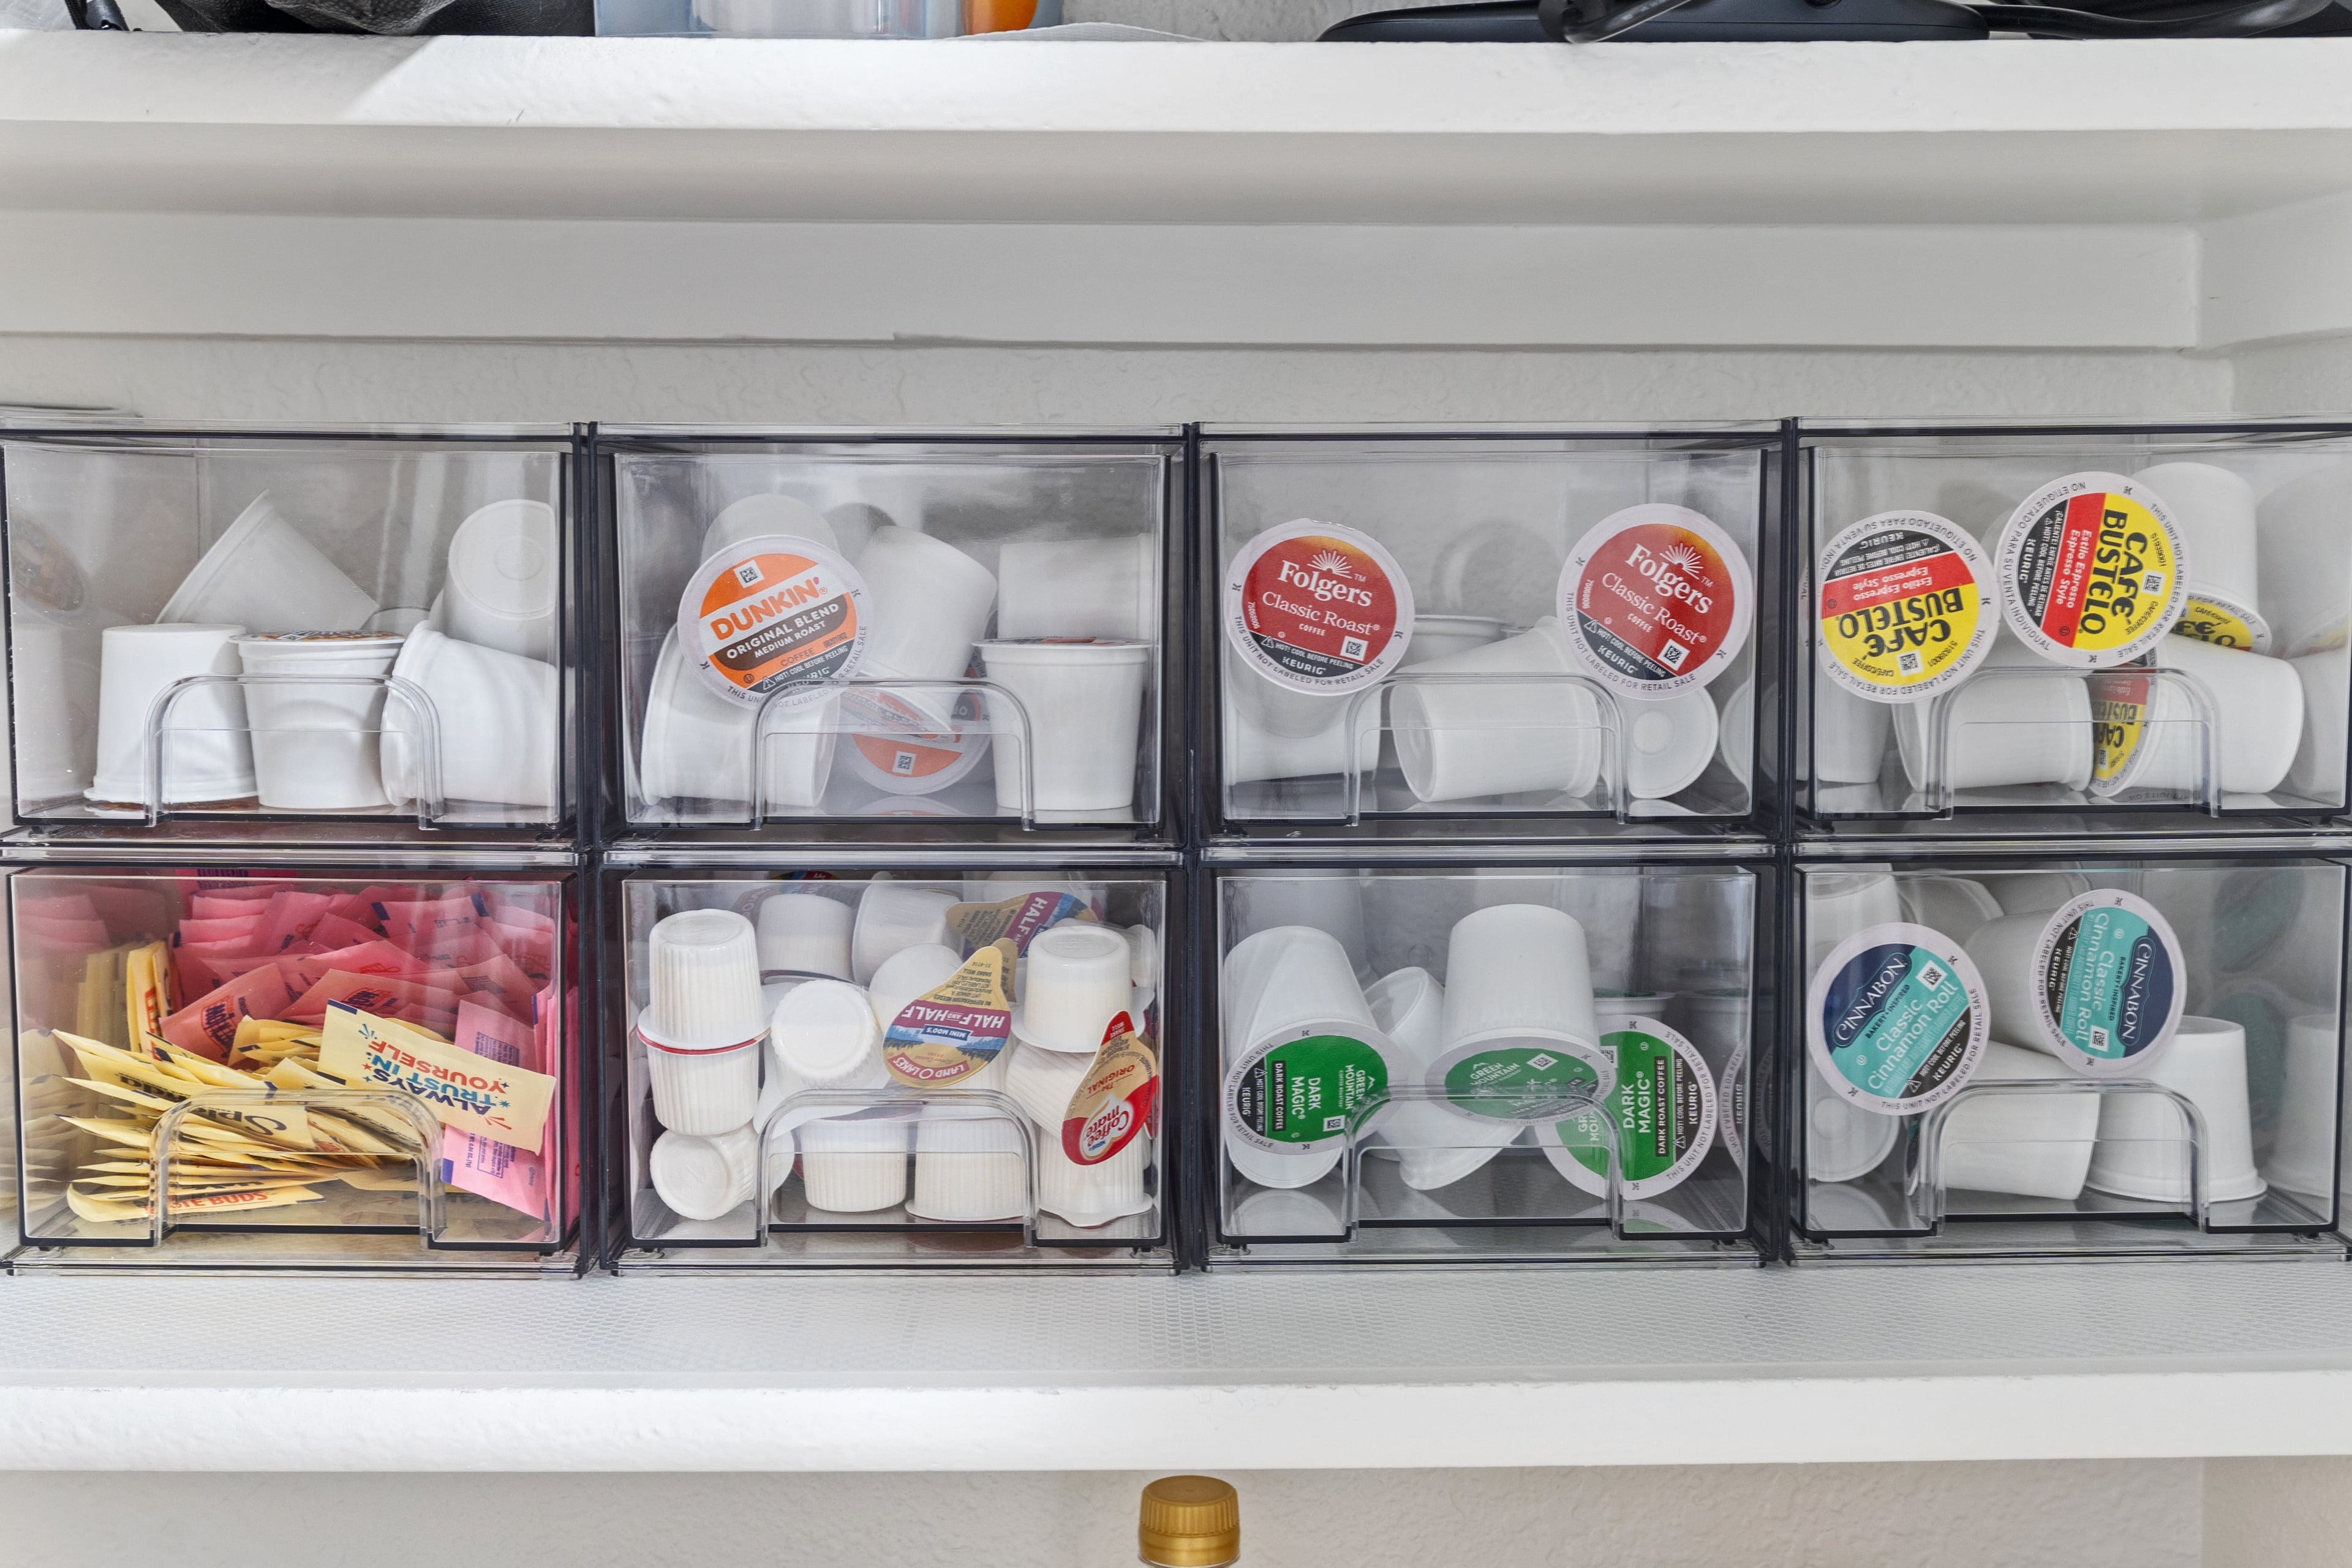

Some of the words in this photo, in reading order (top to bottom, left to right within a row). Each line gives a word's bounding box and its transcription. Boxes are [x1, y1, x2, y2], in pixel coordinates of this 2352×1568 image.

[2071, 481, 2086, 491] NO
[1834, 527, 1864, 549] VENTA
[2009, 532, 2022, 555] PARA
[2078, 529, 2092, 560] Estilo
[2003, 558, 2011, 572] SU
[2019, 538, 2036, 583] KEURIG
[2062, 529, 2081, 575] Espresso
[1278, 560, 1372, 607] Folgers
[1626, 543, 1713, 614] Folgers
[1883, 567, 1928, 584] Espresso
[1902, 577, 1932, 589] Estilo
[2034, 559, 2045, 581] BEFORE
[2081, 508, 2128, 635] BUSTELO
[2171, 560, 2184, 603] LABELED
[1602, 572, 1654, 614] Classic
[1852, 579, 1879, 590] Style
[1853, 583, 1899, 601] Espresso
[2003, 575, 2013, 605] VENTA
[2056, 579, 2070, 605] Style
[2067, 562, 2086, 608] Espresso
[1262, 591, 1320, 621] Classic
[1839, 587, 1964, 639] BUSTELO
[726, 626, 793, 659] ORIGINAL
[795, 603, 839, 627] BLEND
[858, 625, 867, 647] SALE
[1298, 623, 1325, 636] COFFEE
[1627, 613, 1653, 632] COFFEE
[2010, 607, 2049, 650] INDIVIDUAL
[755, 637, 793, 658] MEDIUM
[796, 621, 826, 640] ROAST
[1567, 614, 1579, 636] UNIT
[1575, 638, 1588, 654] NOT
[1585, 654, 1618, 682] LABELED
[1621, 679, 1638, 690] FOR
[1674, 674, 1697, 687] SALE
[775, 673, 789, 682] HOT!
[790, 666, 804, 675] COOL
[805, 656, 824, 668] BEFORE
[826, 646, 848, 660] PEELING
[780, 648, 815, 666] COFFEE
[1257, 654, 1272, 668] NOT
[1336, 673, 1364, 685] RETAIL
[1365, 658, 1384, 674] SALE
[1282, 657, 1326, 675] KEURIG
[1597, 644, 1638, 674] KEURIG
[1940, 666, 1956, 682] NOT
[727, 686, 745, 699] THIS
[1019, 896, 1048, 935] HALF
[2037, 940, 2054, 976] LABELED
[2048, 948, 2062, 991] KEURIG
[2080, 913, 2109, 1001] Cinnamon
[2116, 956, 2126, 984] BAKERY
[2092, 951, 2115, 1011] Classic
[2121, 943, 2152, 1039] CINNABON
[1836, 958, 1907, 1041] CINNABON
[2108, 989, 2120, 1021] INSPIRED
[901, 1005, 949, 1022] HALF
[947, 1012, 961, 1022] AND
[960, 1014, 1006, 1029] HALF
[1866, 1014, 1888, 1039] BAKERY
[1876, 999, 1923, 1052] Classic
[1971, 1012, 1983, 1042] RETAIL
[2075, 1007, 2092, 1041] Roll
[925, 1027, 948, 1038] MOO'S
[949, 1028, 967, 1039] MINI
[1666, 1031, 1685, 1049] SALE
[1868, 1014, 1931, 1090] Cinnamon
[1926, 981, 1958, 1013] Roll
[1256, 1042, 1274, 1055] THIS
[1686, 1048, 1708, 1071] RETAIL
[1932, 1043, 1962, 1081] KEURIG
[1969, 1045, 1979, 1063] FOR
[368, 1039, 507, 1095] YOURSELF
[371, 1054, 400, 1075] IN
[892, 1057, 920, 1077] LAKES
[919, 1067, 934, 1079] O
[935, 1064, 965, 1078] LAND
[1240, 1055, 1255, 1072] UNIT
[1275, 1063, 1284, 1083] DARK
[1470, 1063, 1504, 1080] GREEN
[405, 1071, 498, 1108] TRUST
[1087, 1065, 1135, 1094] ORIGINAL
[1102, 1082, 1114, 1091] The
[1231, 1072, 1243, 1084] NOT
[1345, 1064, 1355, 1110] MOUNTAIN
[1355, 1069, 1366, 1101] GREEN
[1656, 1060, 1665, 1095] COFFEE
[1702, 1075, 1713, 1091] FOR
[372, 1068, 492, 1117] ALWAYS
[1226, 1084, 1236, 1114] LABELED
[1242, 1087, 1251, 1115] KEURIG
[1275, 1084, 1284, 1105] ROAST
[1308, 1077, 1322, 1110] DARK
[1676, 1082, 1684, 1102] BEFORE
[1688, 1082, 1698, 1125] KEURIG
[1085, 1105, 1120, 1134] mate
[1229, 1114, 1239, 1125] FOR
[1275, 1107, 1284, 1129] COFFEE
[1621, 1084, 1635, 1129] DARK
[1657, 1096, 1667, 1130] ROAST
[1676, 1104, 1684, 1120] COOL
[1703, 1092, 1714, 1130] LABELED
[1087, 1110, 1129, 1147] Coffee
[1235, 1123, 1254, 1143] RETAIL
[1697, 1135, 1708, 1148] NOT
[1254, 1138, 1274, 1148] SALE
[1657, 1131, 1667, 1155] DARK
[1685, 1148, 1698, 1167] UNIT
[1666, 1165, 1685, 1180] THIS
[211, 1191, 269, 1205] BUDS
